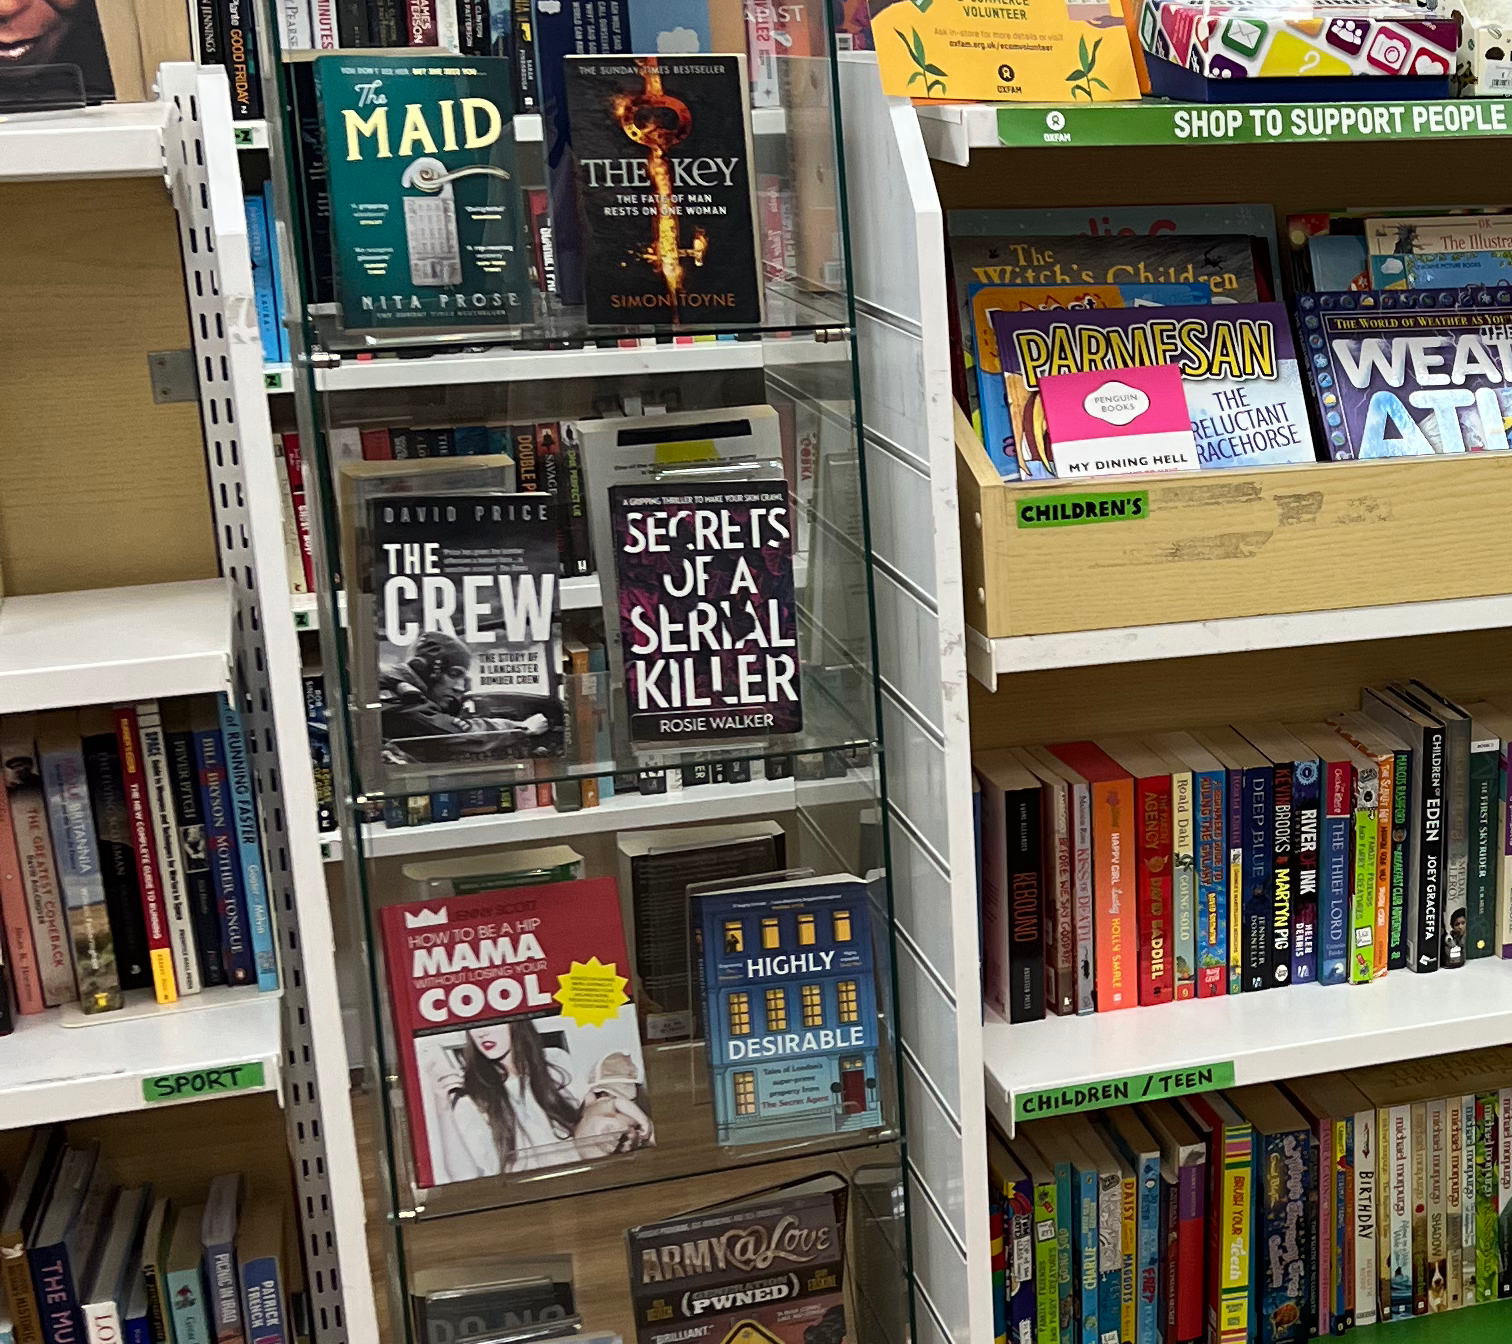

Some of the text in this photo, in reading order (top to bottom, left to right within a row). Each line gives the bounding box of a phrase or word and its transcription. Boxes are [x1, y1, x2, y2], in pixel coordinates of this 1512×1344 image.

[234, 63, 249, 105] FRIDAY
[341, 98, 502, 161] MAID
[1174, 109, 1241, 138] SHOP
[1250, 109, 1282, 137] TO
[1291, 106, 1405, 136] SUPPORT
[1413, 104, 1505, 132] PEOPLE
[580, 159, 650, 188] THE
[610, 293, 736, 308] SIMON TOYNE
[1014, 320, 1277, 391] PARMESAN
[1212, 387, 1250, 411] THE
[1192, 402, 1290, 441] RELUCTANT
[1069, 454, 1188, 473] MY DINING HELL
[1197, 424, 1301, 465] RACEHORSE
[623, 508, 790, 553] SECRETS
[1021, 498, 1143, 523] CHILDREN'S
[382, 543, 440, 574] THE
[663, 556, 758, 597] OF A
[384, 573, 555, 646] CREW
[630, 599, 796, 655] SERIAL
[637, 654, 799, 709] KILLER
[660, 714, 774, 733] ROSIE WALKER
[1426, 799, 1440, 842] EDEN
[413, 933, 546, 978] MAMA
[747, 951, 835, 978] HIGHLY
[418, 974, 552, 1022] COOL
[728, 1026, 864, 1060] DESIRABLE
[155, 1067, 244, 1098] SPORT
[1022, 1081, 1129, 1113] CHILDREN
[1159, 1068, 1213, 1093] TEEN
[1357, 1171, 1374, 1240] BIRTHDAY
[692, 1283, 789, 1315] PWNED
